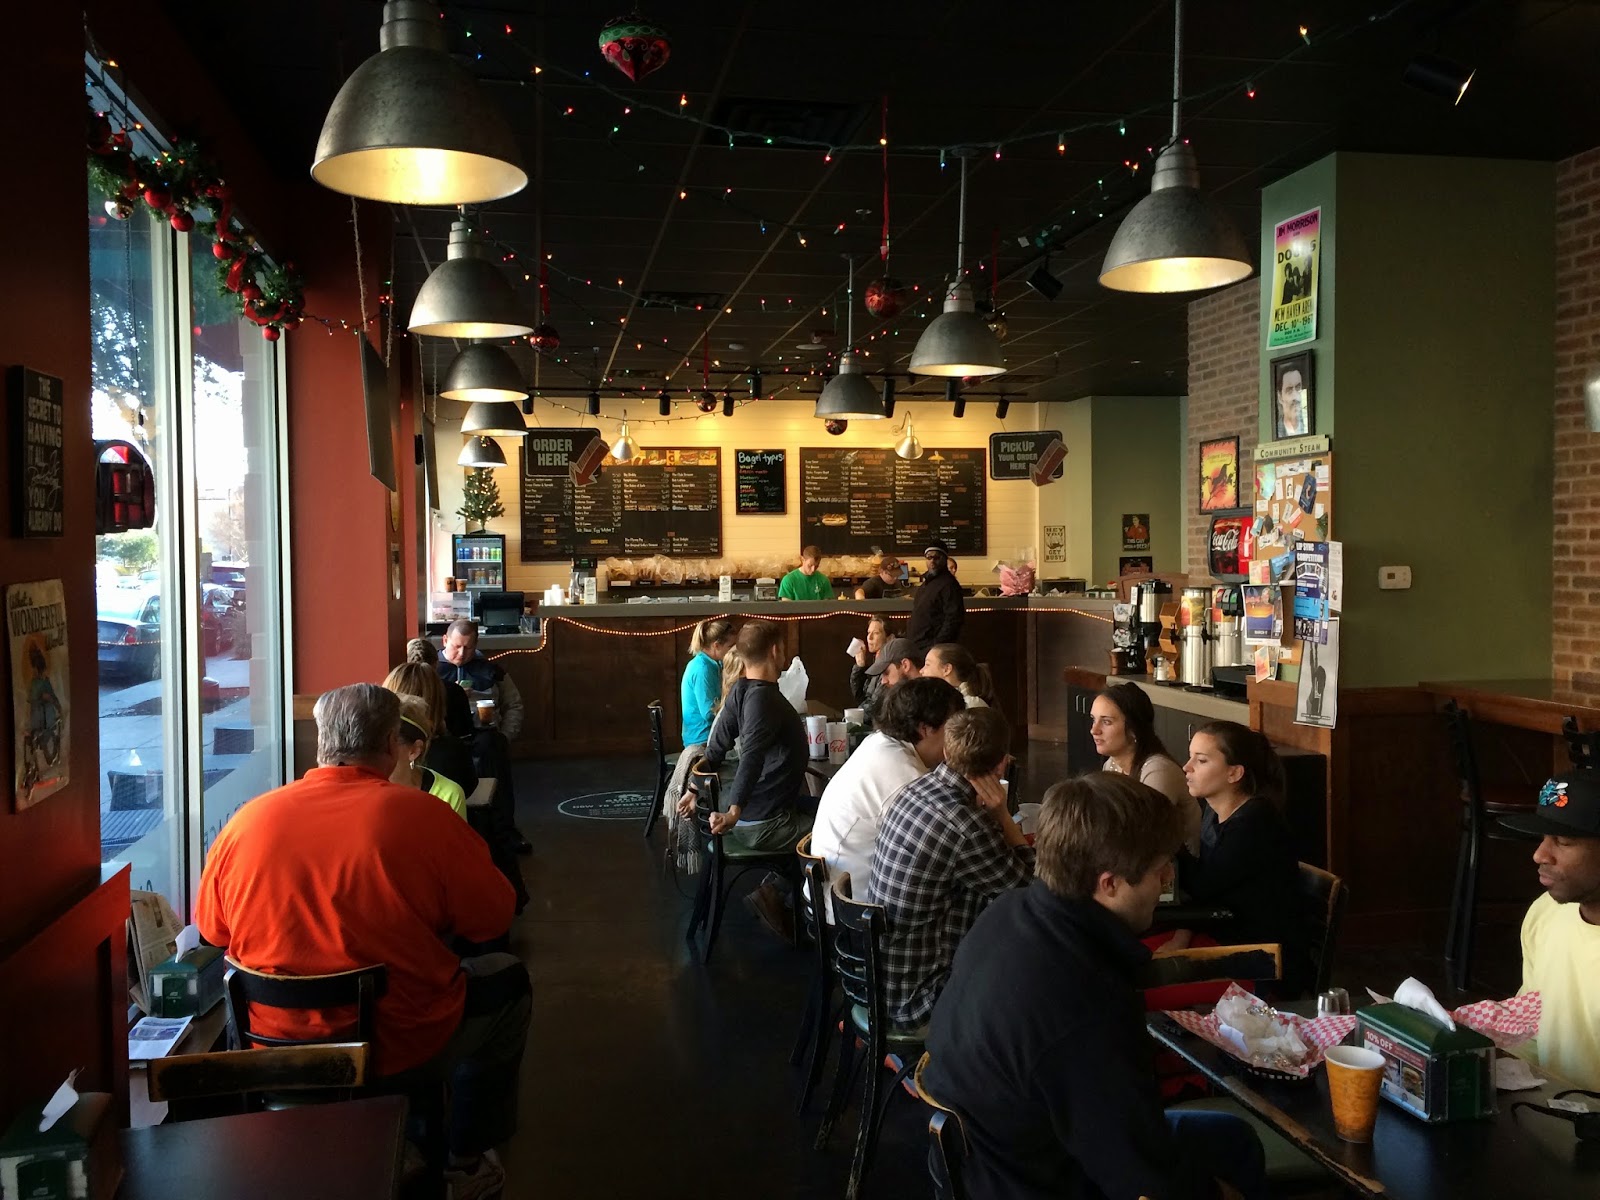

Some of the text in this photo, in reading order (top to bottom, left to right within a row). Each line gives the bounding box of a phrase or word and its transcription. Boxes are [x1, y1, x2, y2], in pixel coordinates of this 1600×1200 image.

[1277, 213, 1318, 238] JIM MORRISON
[1277, 239, 1317, 264] DOS
[1274, 307, 1285, 322] NEW
[1286, 302, 1301, 320] HAVEN
[38, 376, 51, 400] THE
[28, 396, 62, 425] SECRET TO
[27, 420, 62, 448] HAVING
[532, 438, 573, 452] ORDER
[1260, 443, 1321, 459] COMMUNITY STEAM
[537, 453, 569, 466] HERE
[738, 451, 762, 465] Bagel
[998, 453, 1038, 462] YOUR ORDER
[1010, 462, 1027, 470] HERE
[28, 486, 46, 509] YOU
[10, 602, 65, 637] WONDERFUL
[1366, 1031, 1394, 1051] 10% OFF
